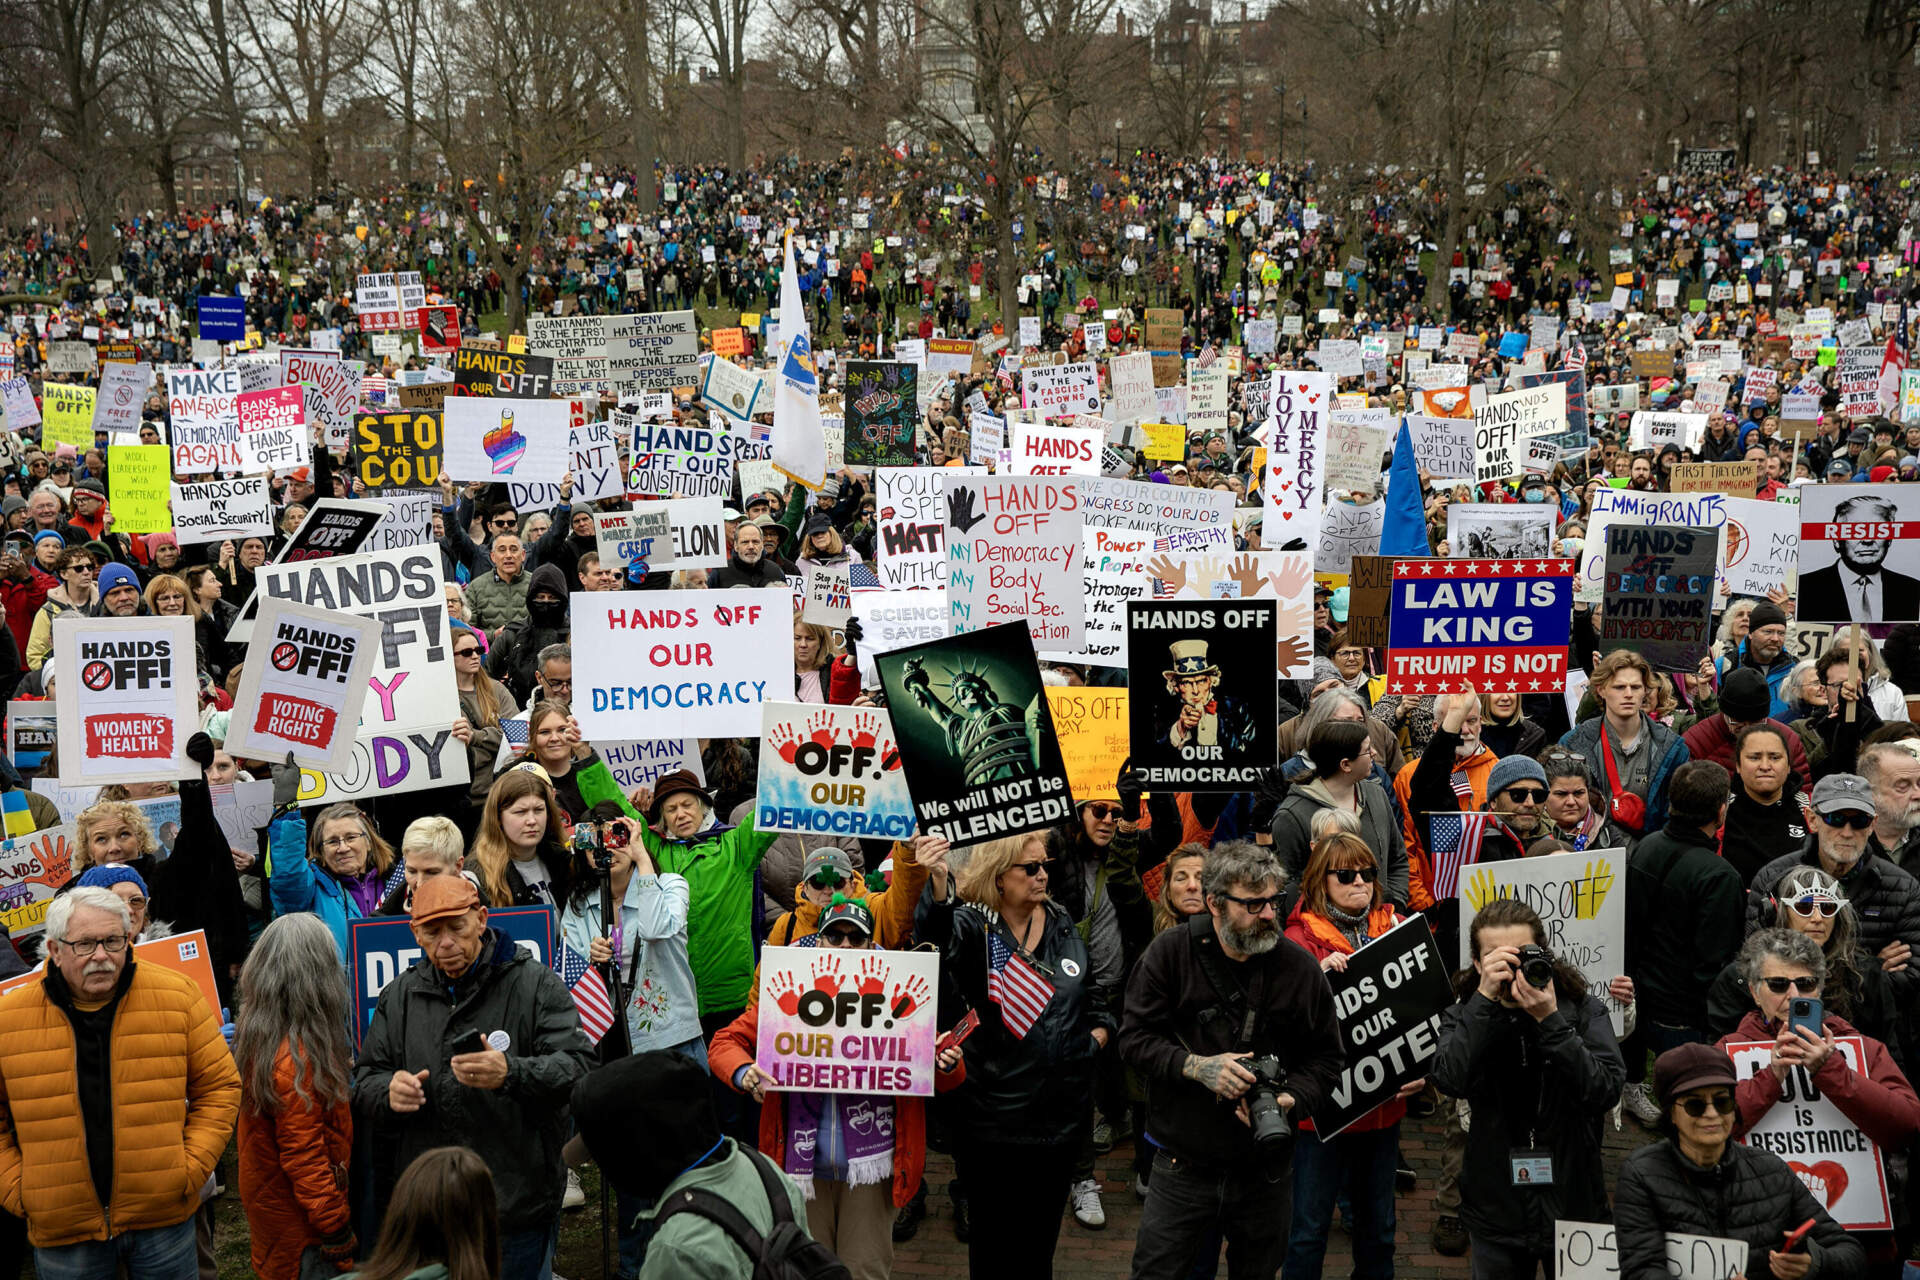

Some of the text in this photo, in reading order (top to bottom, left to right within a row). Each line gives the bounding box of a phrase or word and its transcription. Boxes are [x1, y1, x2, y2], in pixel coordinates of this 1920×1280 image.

[359, 274, 379, 289] REAL
[535, 318, 602, 330] GUANTANAMO
[613, 323, 686, 337] HATE A HOME
[634, 315, 663, 326] DENY
[533, 327, 605, 339] IS THE FIRST
[629, 336, 673, 348] DEFEND
[530, 338, 606, 350] CONCENTRATIO
[559, 348, 586, 358] CAMP
[642, 347, 663, 357] THE
[457, 351, 526, 375] HANDS
[556, 358, 605, 370] WILL NOT
[609, 354, 697, 369] MARGINALIZED
[1032, 364, 1091, 378] SHUT DOWN
[1837, 357, 1858, 365] ARE
[172, 371, 237, 395] MAKE
[335, 361, 360, 387] THOSE
[559, 368, 608, 379] THE LAST
[615, 376, 698, 390] THE FASCISTS
[632, 367, 677, 379] DEPOSE
[1051, 377, 1071, 385] THE
[1843, 369, 1878, 381] THROW
[286, 358, 356, 417] BUNGLING
[407, 385, 447, 397] TRUMP
[496, 372, 548, 396] OFF
[1041, 384, 1085, 396] FASCIST
[46, 386, 92, 403] HANDS
[241, 396, 276, 412] BANS
[643, 400, 663, 409] OFF!
[853, 389, 900, 417] HANDS
[1043, 393, 1085, 406] CLOWNS
[1191, 394, 1212, 402] PEOPLE
[1862, 391, 1877, 401] THE
[56, 401, 91, 416] OFF!
[107, 408, 132, 418] FREE
[171, 397, 239, 420] AMERICA
[241, 404, 300, 423] OFF OUR
[1187, 410, 1227, 420] POWERFUL
[1273, 375, 1294, 454] LOVE
[1475, 400, 1519, 428] HANDS
[1694, 401, 1720, 413] NOT
[242, 414, 295, 433] BODIES
[1336, 412, 1384, 423] TOO MUCH
[1651, 420, 1677, 429] HANDS
[174, 422, 241, 446] DEMOCRATIC
[1425, 422, 1451, 434] THE
[1476, 423, 1517, 450] OFF!
[1651, 427, 1677, 437] OFF!
[249, 429, 293, 450] HANDS
[633, 424, 731, 456] HANDS
[1026, 435, 1092, 461] HANDS
[1529, 440, 1558, 452] HANDS
[124, 452, 147, 461] MODEL
[176, 443, 243, 466] AGAIN
[257, 442, 302, 463] OFF!
[381, 445, 412, 457] THE
[1296, 411, 1319, 509] MERCY
[1486, 447, 1510, 463] OUR
[112, 464, 157, 474] LEADERSHIP
[686, 456, 731, 479] OUR
[1478, 461, 1514, 481] BODIES
[1674, 464, 1730, 479] FIRST THEY
[180, 480, 262, 501] HANDS OFF
[628, 468, 731, 498] CONSTITUTION
[879, 472, 927, 499] YOU
[1681, 480, 1713, 491] FOR THE
[983, 483, 1078, 513] HANDS
[1152, 486, 1217, 504] COUNTRY
[321, 513, 364, 527] HANDS
[401, 500, 430, 523] OFF
[1138, 502, 1219, 523] DO YOUR JOB
[119, 519, 164, 531] INTEGRITY
[600, 517, 628, 529] HATE
[602, 525, 668, 541] MAKE AMERICA
[993, 511, 1050, 536] OFF
[1824, 521, 1904, 539] RESIST
[385, 522, 433, 551] BODY!
[1096, 531, 1146, 552] Power
[1168, 528, 1226, 550] EMPATHY
[1611, 528, 1696, 556] HANDS
[617, 538, 655, 559] GREAT
[975, 539, 1075, 572] Democracy
[1100, 555, 1144, 576] People
[1749, 563, 1775, 575] JUST
[266, 556, 436, 610] HANDS
[814, 582, 831, 591] your
[989, 565, 1042, 593] Body
[1607, 573, 1711, 596] DEMOCRACY
[1084, 577, 1144, 602] Stronger
[1405, 581, 1556, 609] LAW IS
[870, 607, 949, 621] SCIENCE
[986, 591, 1064, 617] Social Sec.
[1094, 600, 1115, 613] the
[608, 603, 761, 630] HANDS OFF
[1111, 620, 1122, 631] in
[1132, 610, 1270, 630] HANDS OFF
[277, 622, 356, 654] HANDS
[883, 625, 944, 640] SAVES
[1423, 616, 1533, 643] KING
[82, 640, 171, 660] HANDS
[649, 642, 713, 667] OUR
[1394, 653, 1563, 675] TRUMP IS NOT
[592, 680, 766, 713] DEMOCRACY
[272, 699, 325, 724] VOTING
[1091, 696, 1126, 720] OFF
[93, 719, 165, 738] WOMEN'S
[267, 716, 321, 741] RIGHTS
[101, 736, 159, 754] HEALTH
[605, 738, 684, 765] HUMAN
[1181, 745, 1224, 760] OUR
[1136, 766, 1270, 782] DEMOCRACY
[811, 782, 866, 806] OUR
[919, 775, 1064, 820] We will NOT be
[759, 805, 917, 838] DEMOCRACY
[927, 795, 1071, 843] SILENCED!
[1559, 875, 1612, 918] OFF
[1382, 941, 1429, 989] OFF
[1351, 1007, 1397, 1045] OUR
[774, 1032, 912, 1062] OUR CIVIL
[771, 1062, 912, 1091] LIBERTIES
[1794, 1104, 1814, 1127] is
[1751, 1128, 1868, 1155] RESISTANCE
